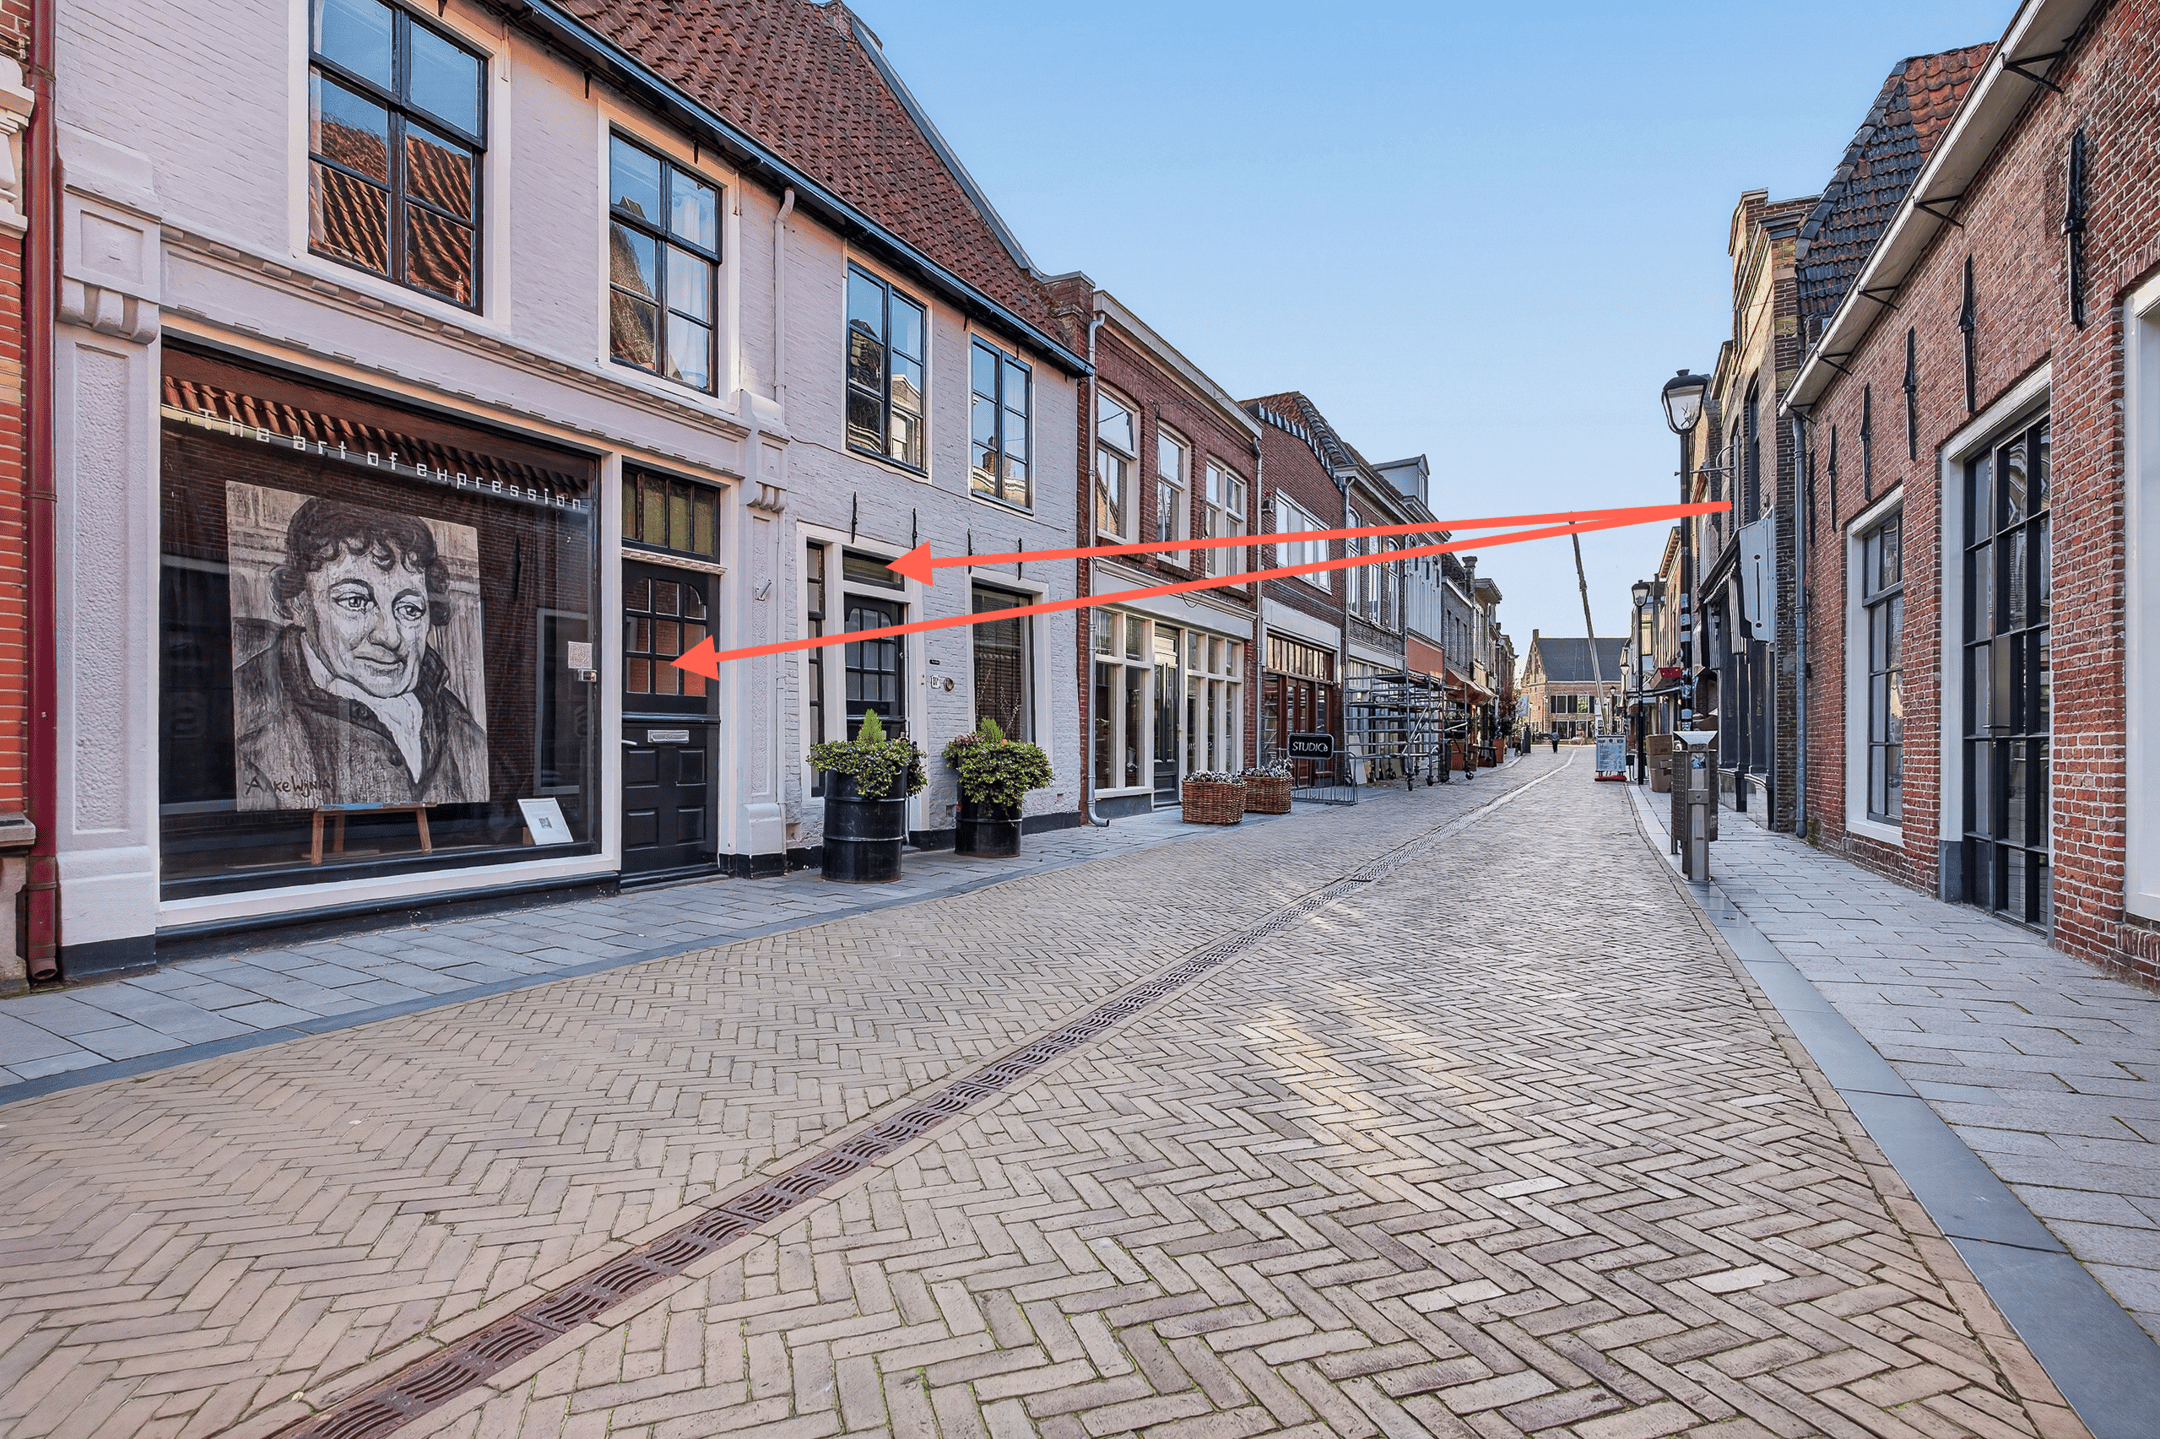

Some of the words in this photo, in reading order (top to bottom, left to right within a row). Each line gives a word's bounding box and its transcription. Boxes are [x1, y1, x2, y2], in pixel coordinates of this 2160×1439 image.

[198, 407, 270, 443] The
[293, 435, 347, 460] art
[367, 451, 399, 471] of
[416, 463, 581, 511] expression
[1292, 741, 1328, 752] STUDIO
